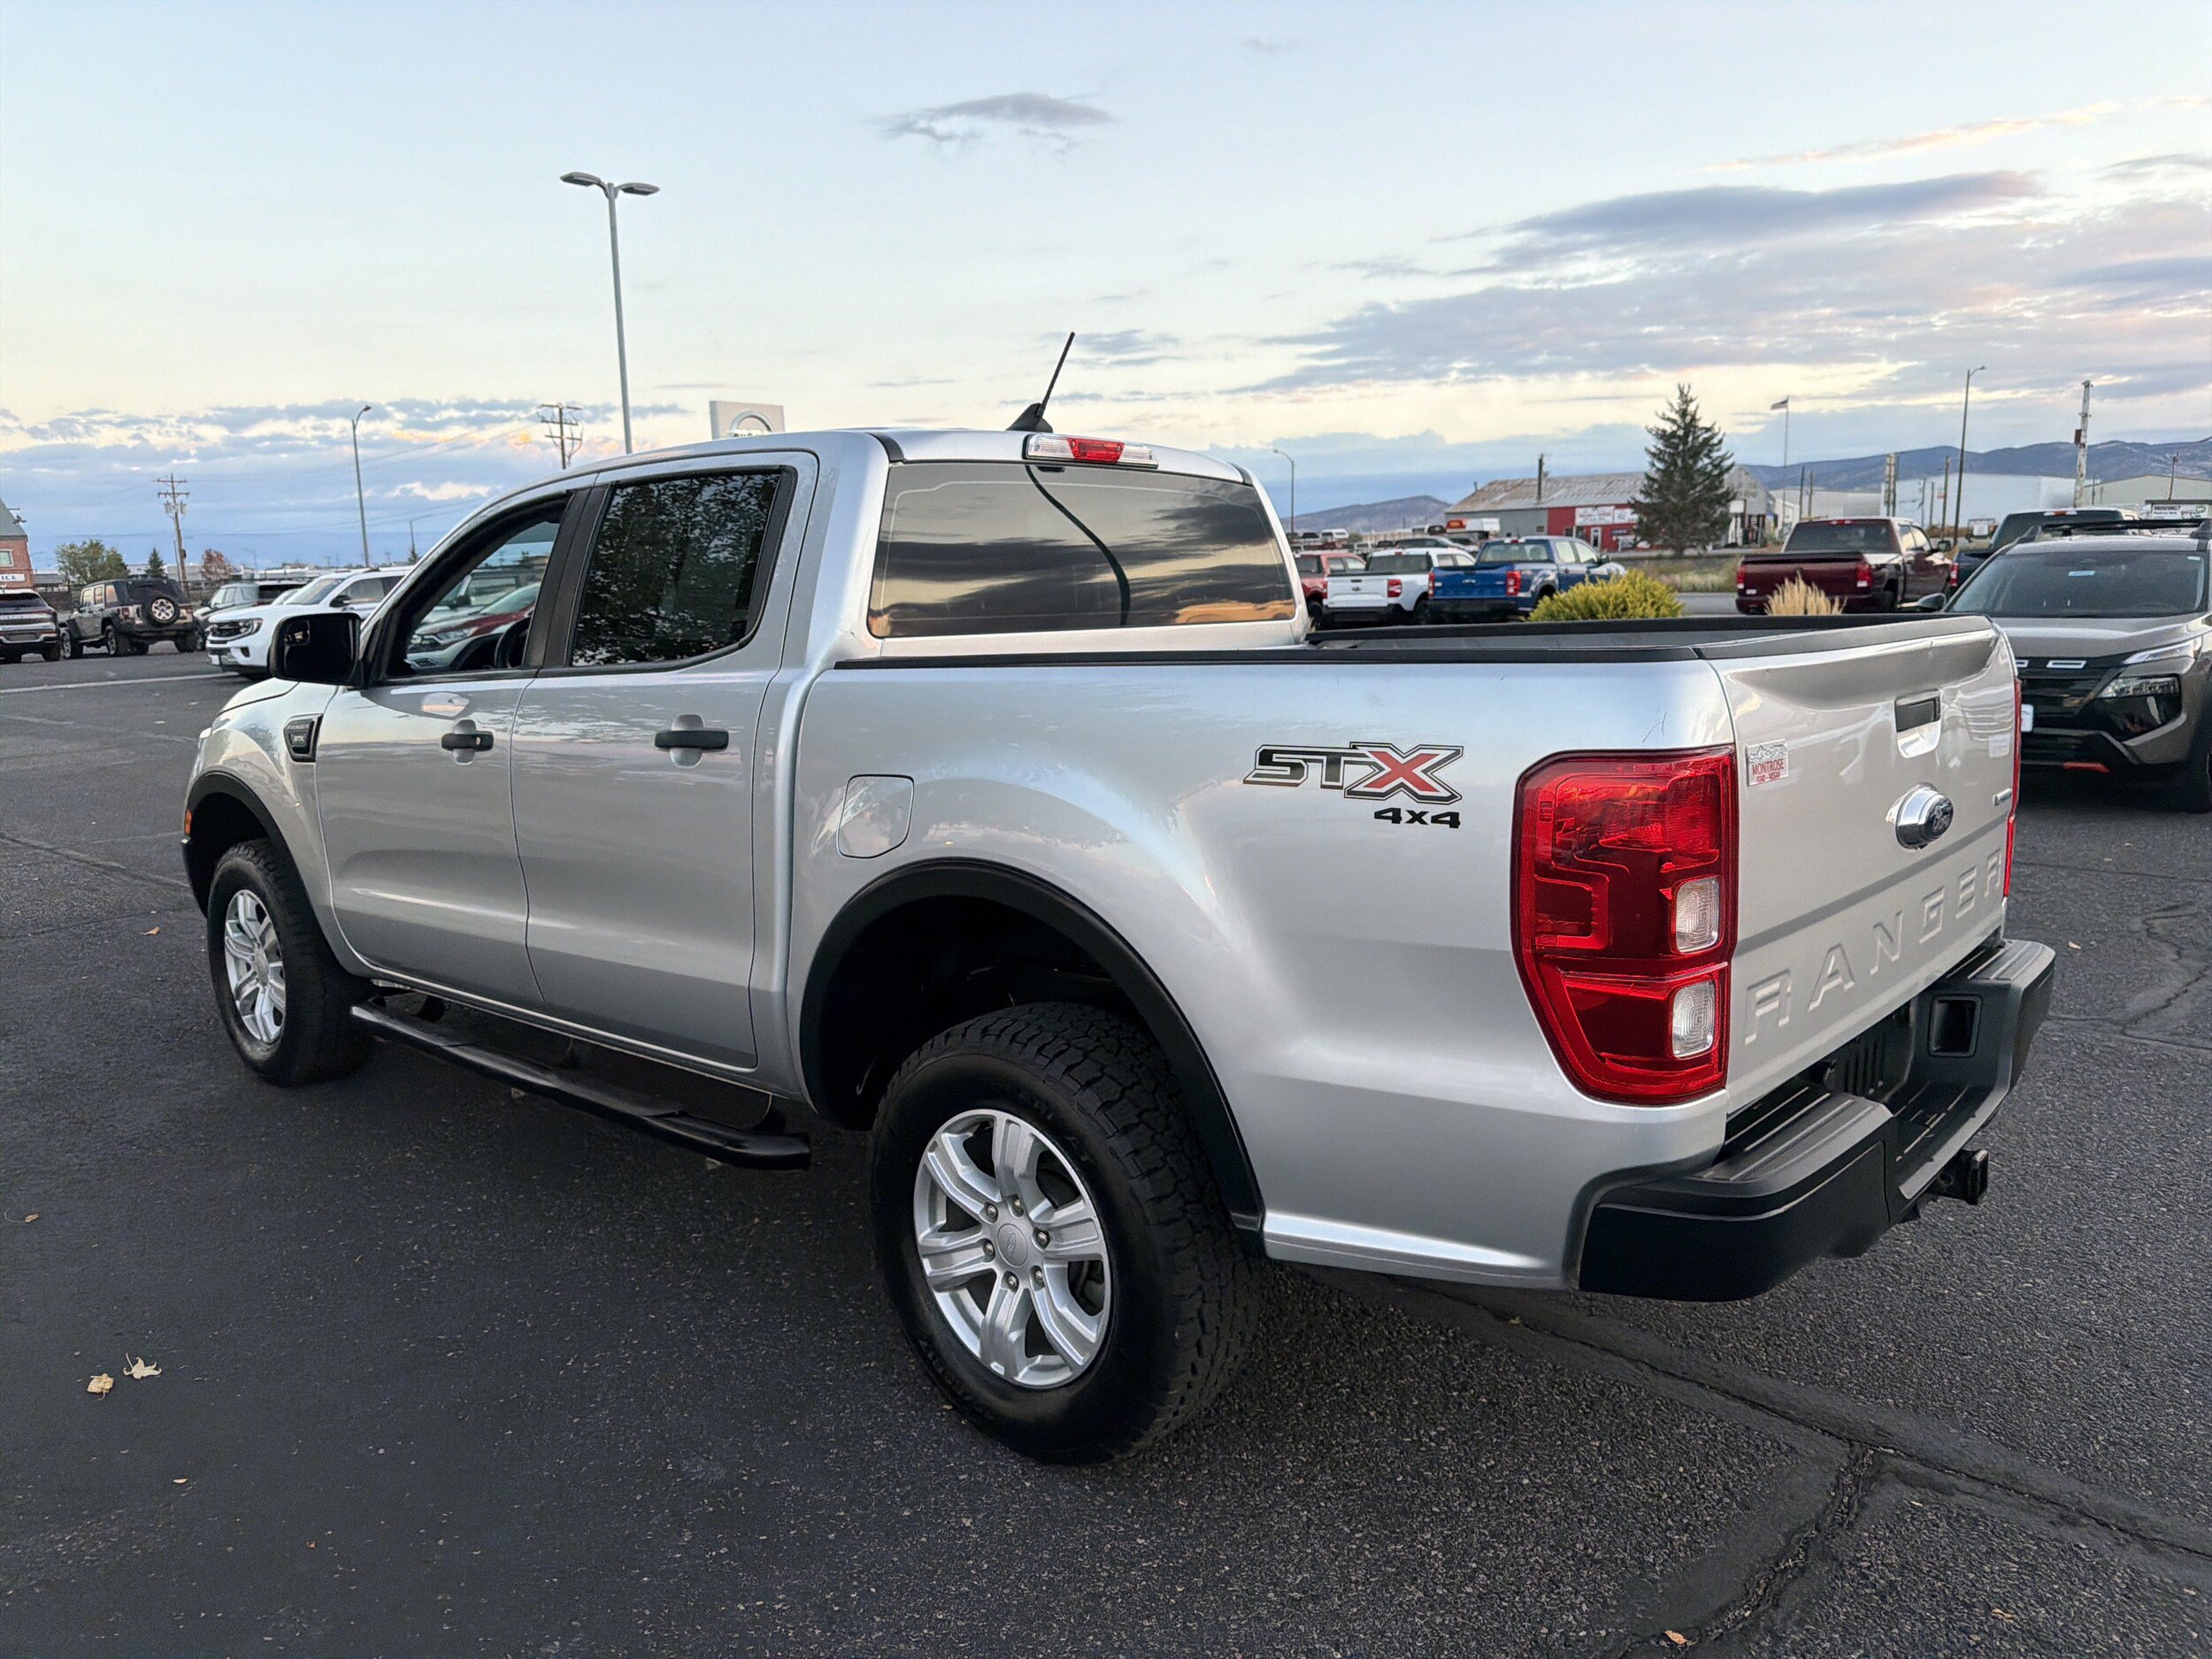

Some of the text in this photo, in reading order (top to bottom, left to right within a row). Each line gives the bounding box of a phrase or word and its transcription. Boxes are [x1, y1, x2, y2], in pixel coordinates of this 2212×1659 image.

[1243, 741, 1464, 805] STX
[1752, 757, 1785, 776] MONTROSE
[1745, 849, 2002, 1046] RANGER
